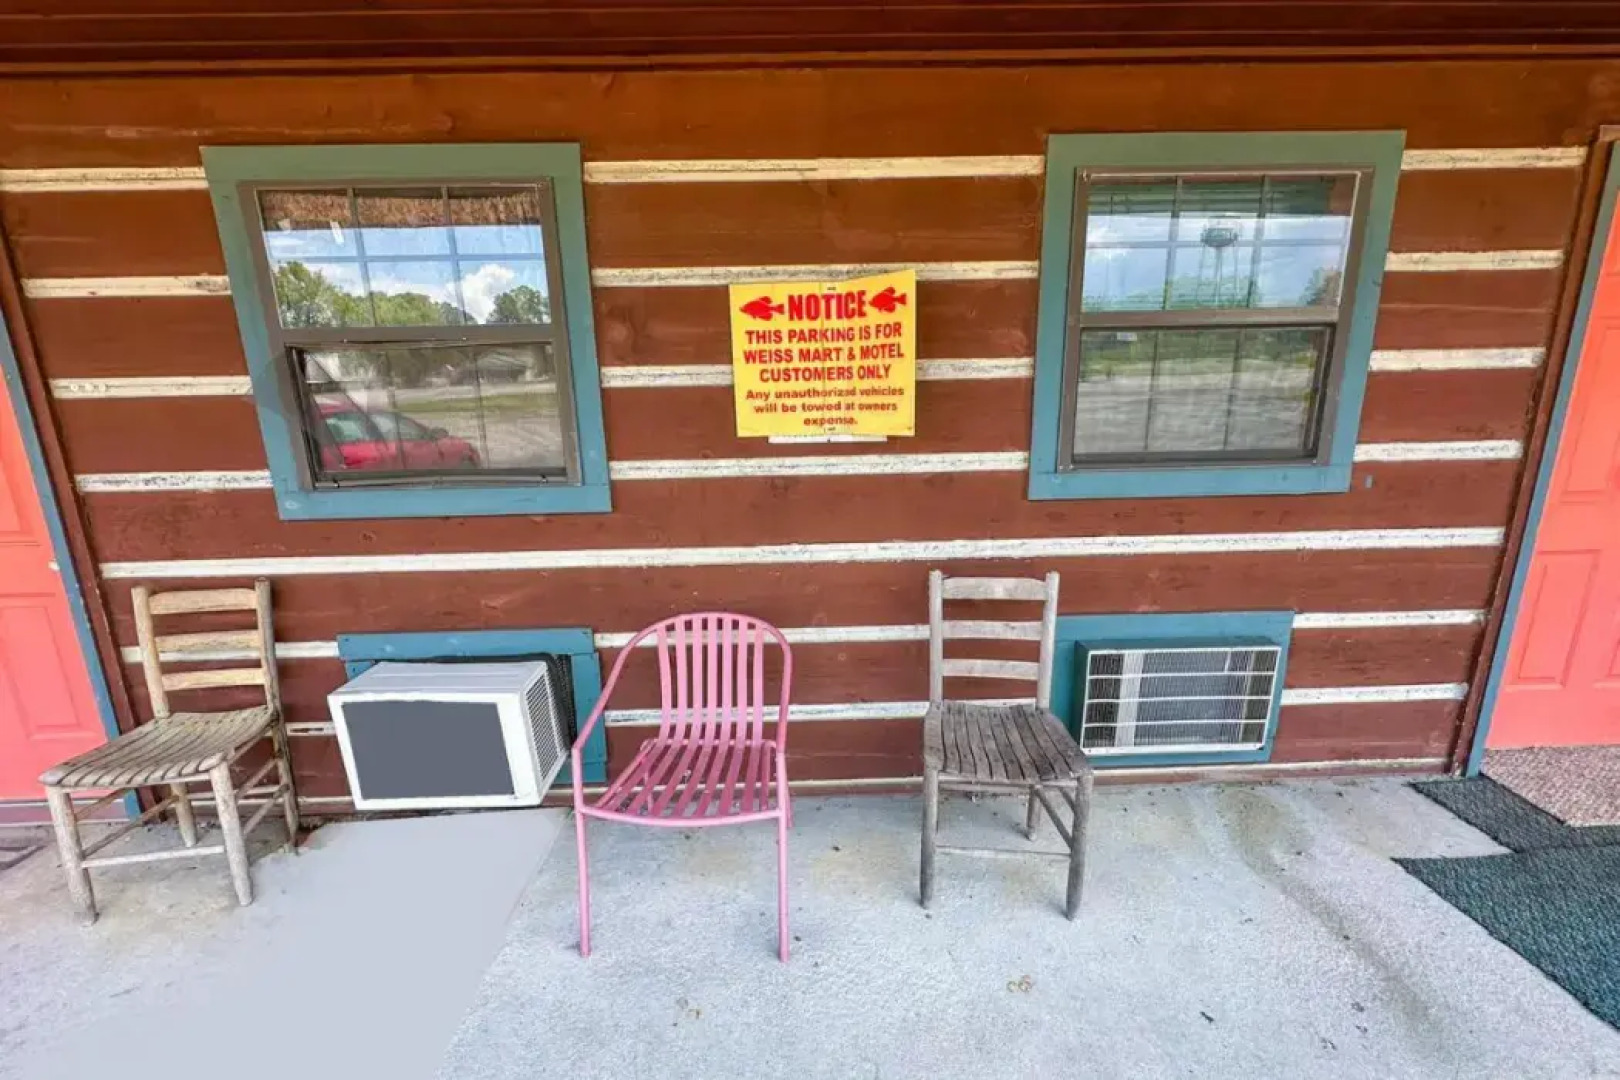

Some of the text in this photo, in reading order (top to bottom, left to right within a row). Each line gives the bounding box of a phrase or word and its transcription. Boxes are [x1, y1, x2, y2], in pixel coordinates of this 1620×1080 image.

[788, 289, 867, 321] NOTICE
[745, 322, 902, 344] THIS PARKING IS FOR
[743, 343, 904, 364] WEISS MART & MOTEL
[759, 364, 891, 382] CUSTOMERS ONLY
[746, 386, 905, 401] Any unauthorized vehicles
[753, 401, 898, 413] will be towed at owners
[803, 416, 858, 427] expense.
